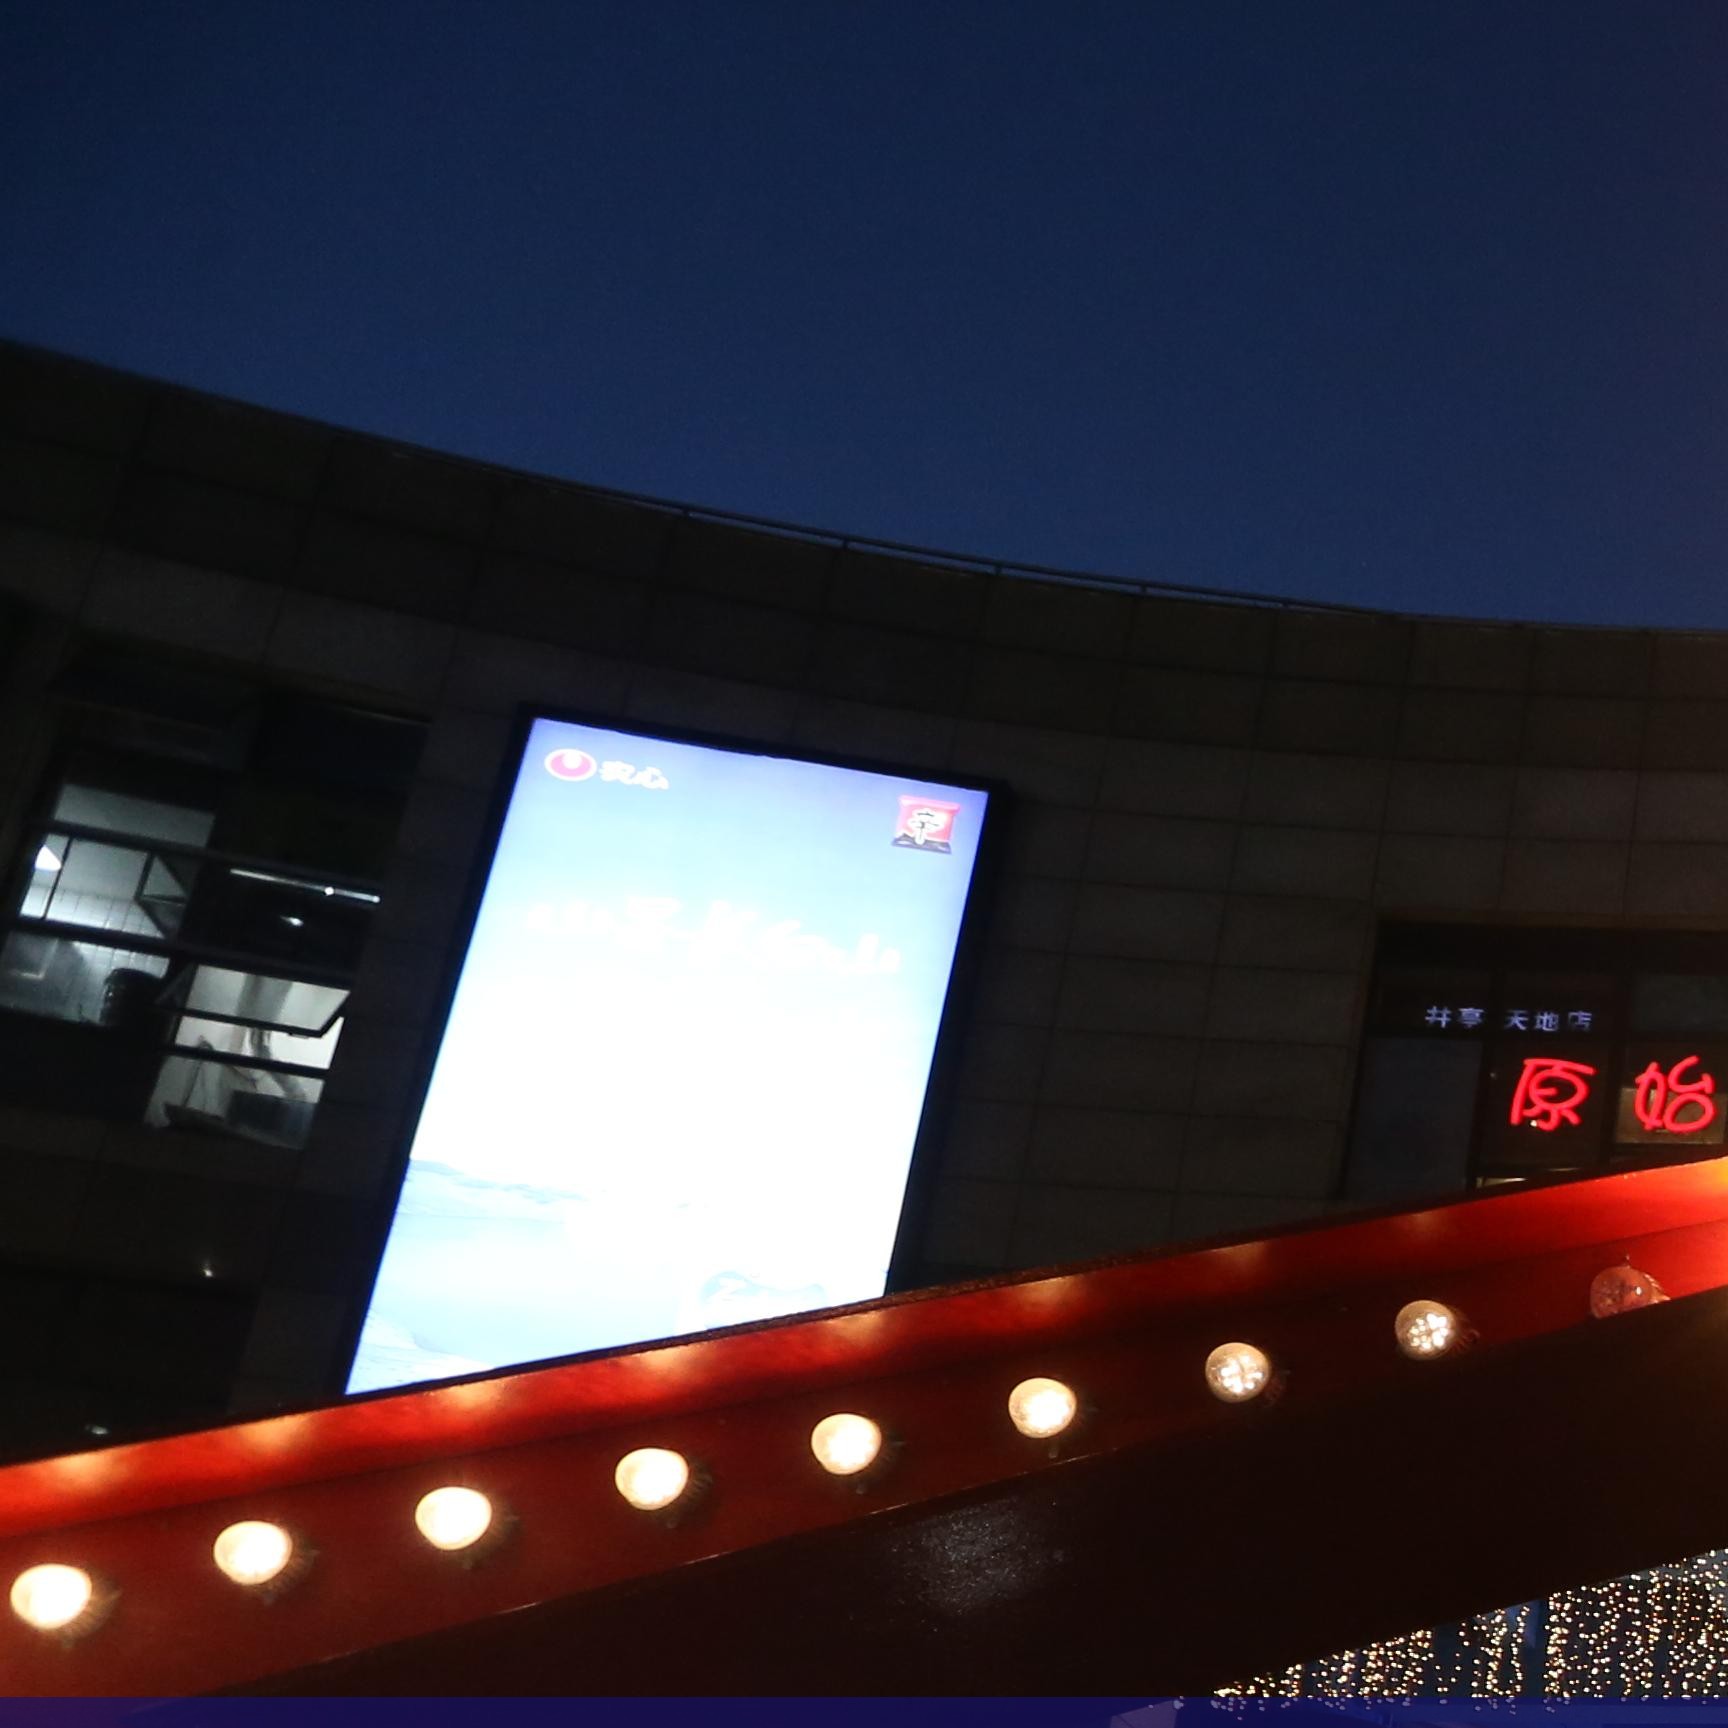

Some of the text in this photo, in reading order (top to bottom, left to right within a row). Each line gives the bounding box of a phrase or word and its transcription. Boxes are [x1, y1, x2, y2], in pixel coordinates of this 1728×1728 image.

[1505, 1009, 1593, 1032] 天地店
[1510, 1055, 1719, 1134] 原始
